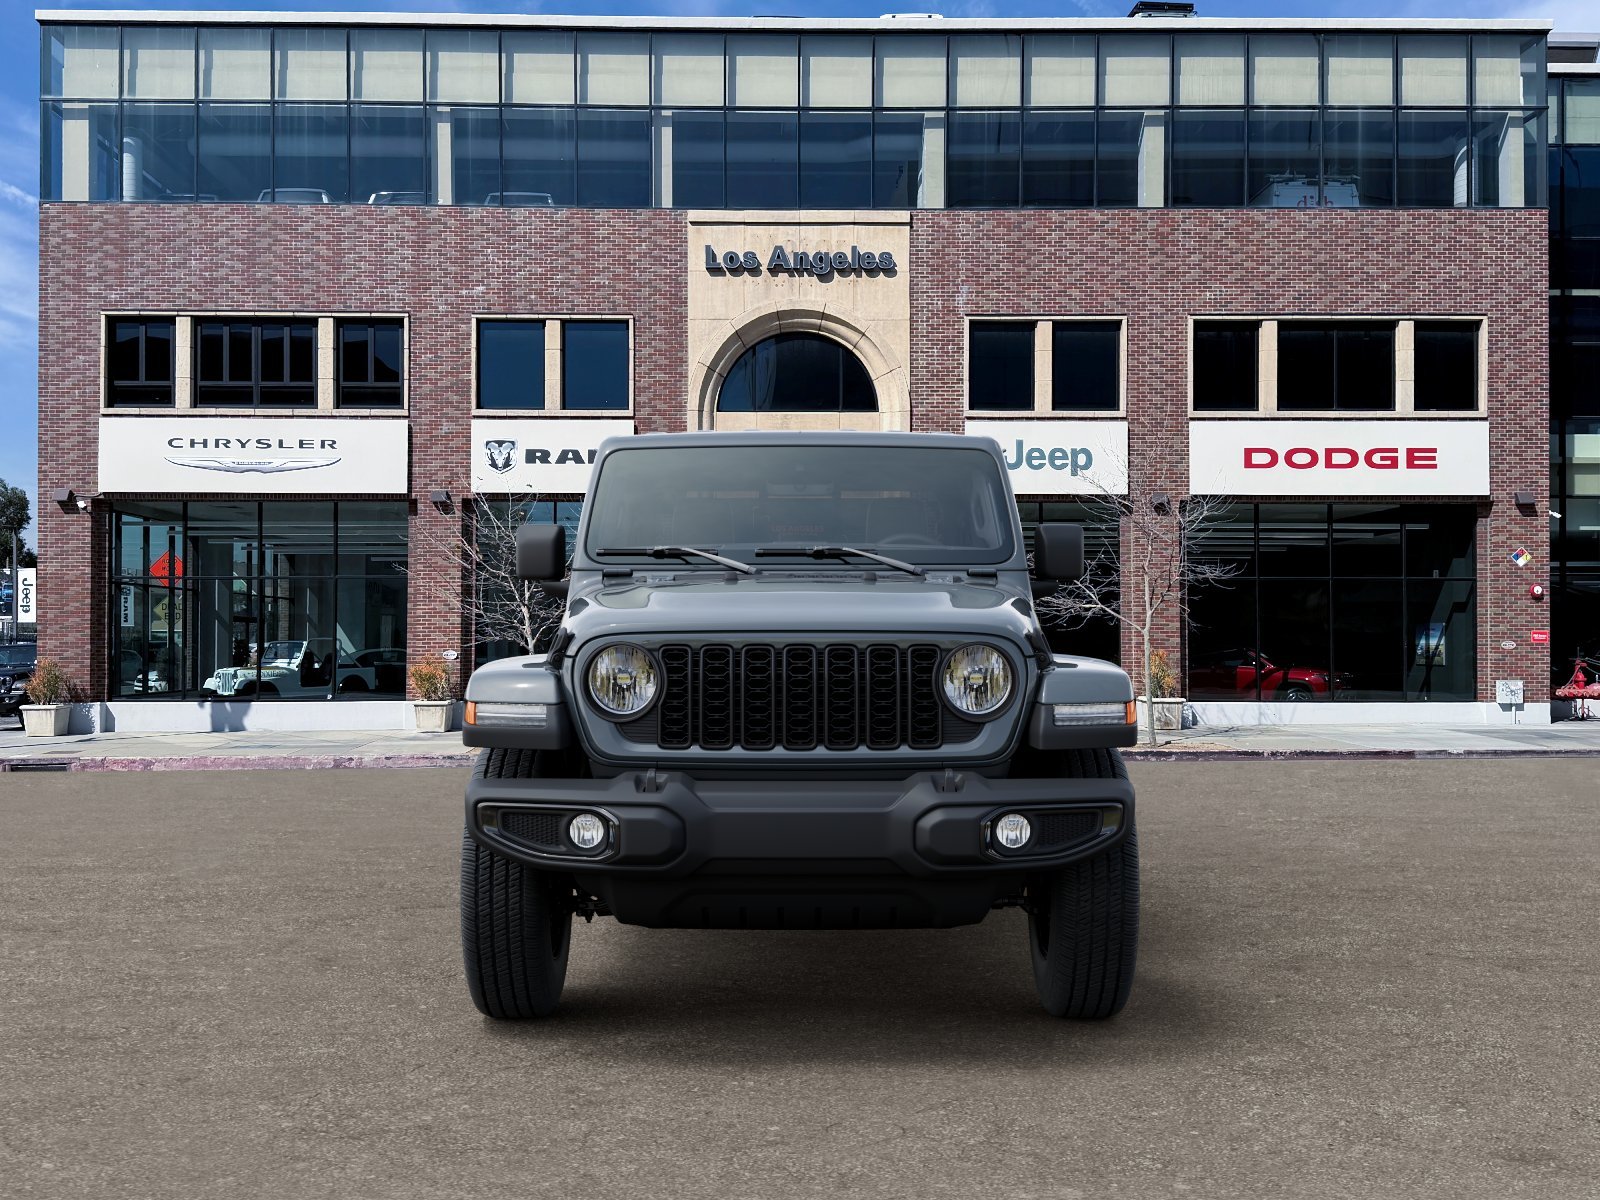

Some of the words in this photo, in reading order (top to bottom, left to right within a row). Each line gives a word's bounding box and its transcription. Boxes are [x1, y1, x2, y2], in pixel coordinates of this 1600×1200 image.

[705, 244, 759, 270] Los
[767, 244, 895, 275] Angeles
[168, 437, 338, 450] CHRYSLER
[525, 448, 598, 465] RA
[1004, 439, 1093, 477] Jeep
[1243, 447, 1438, 470] DODGE
[20, 577, 33, 614] Jeep
[161, 603, 182, 611] DAD
[164, 612, 181, 620] ED
